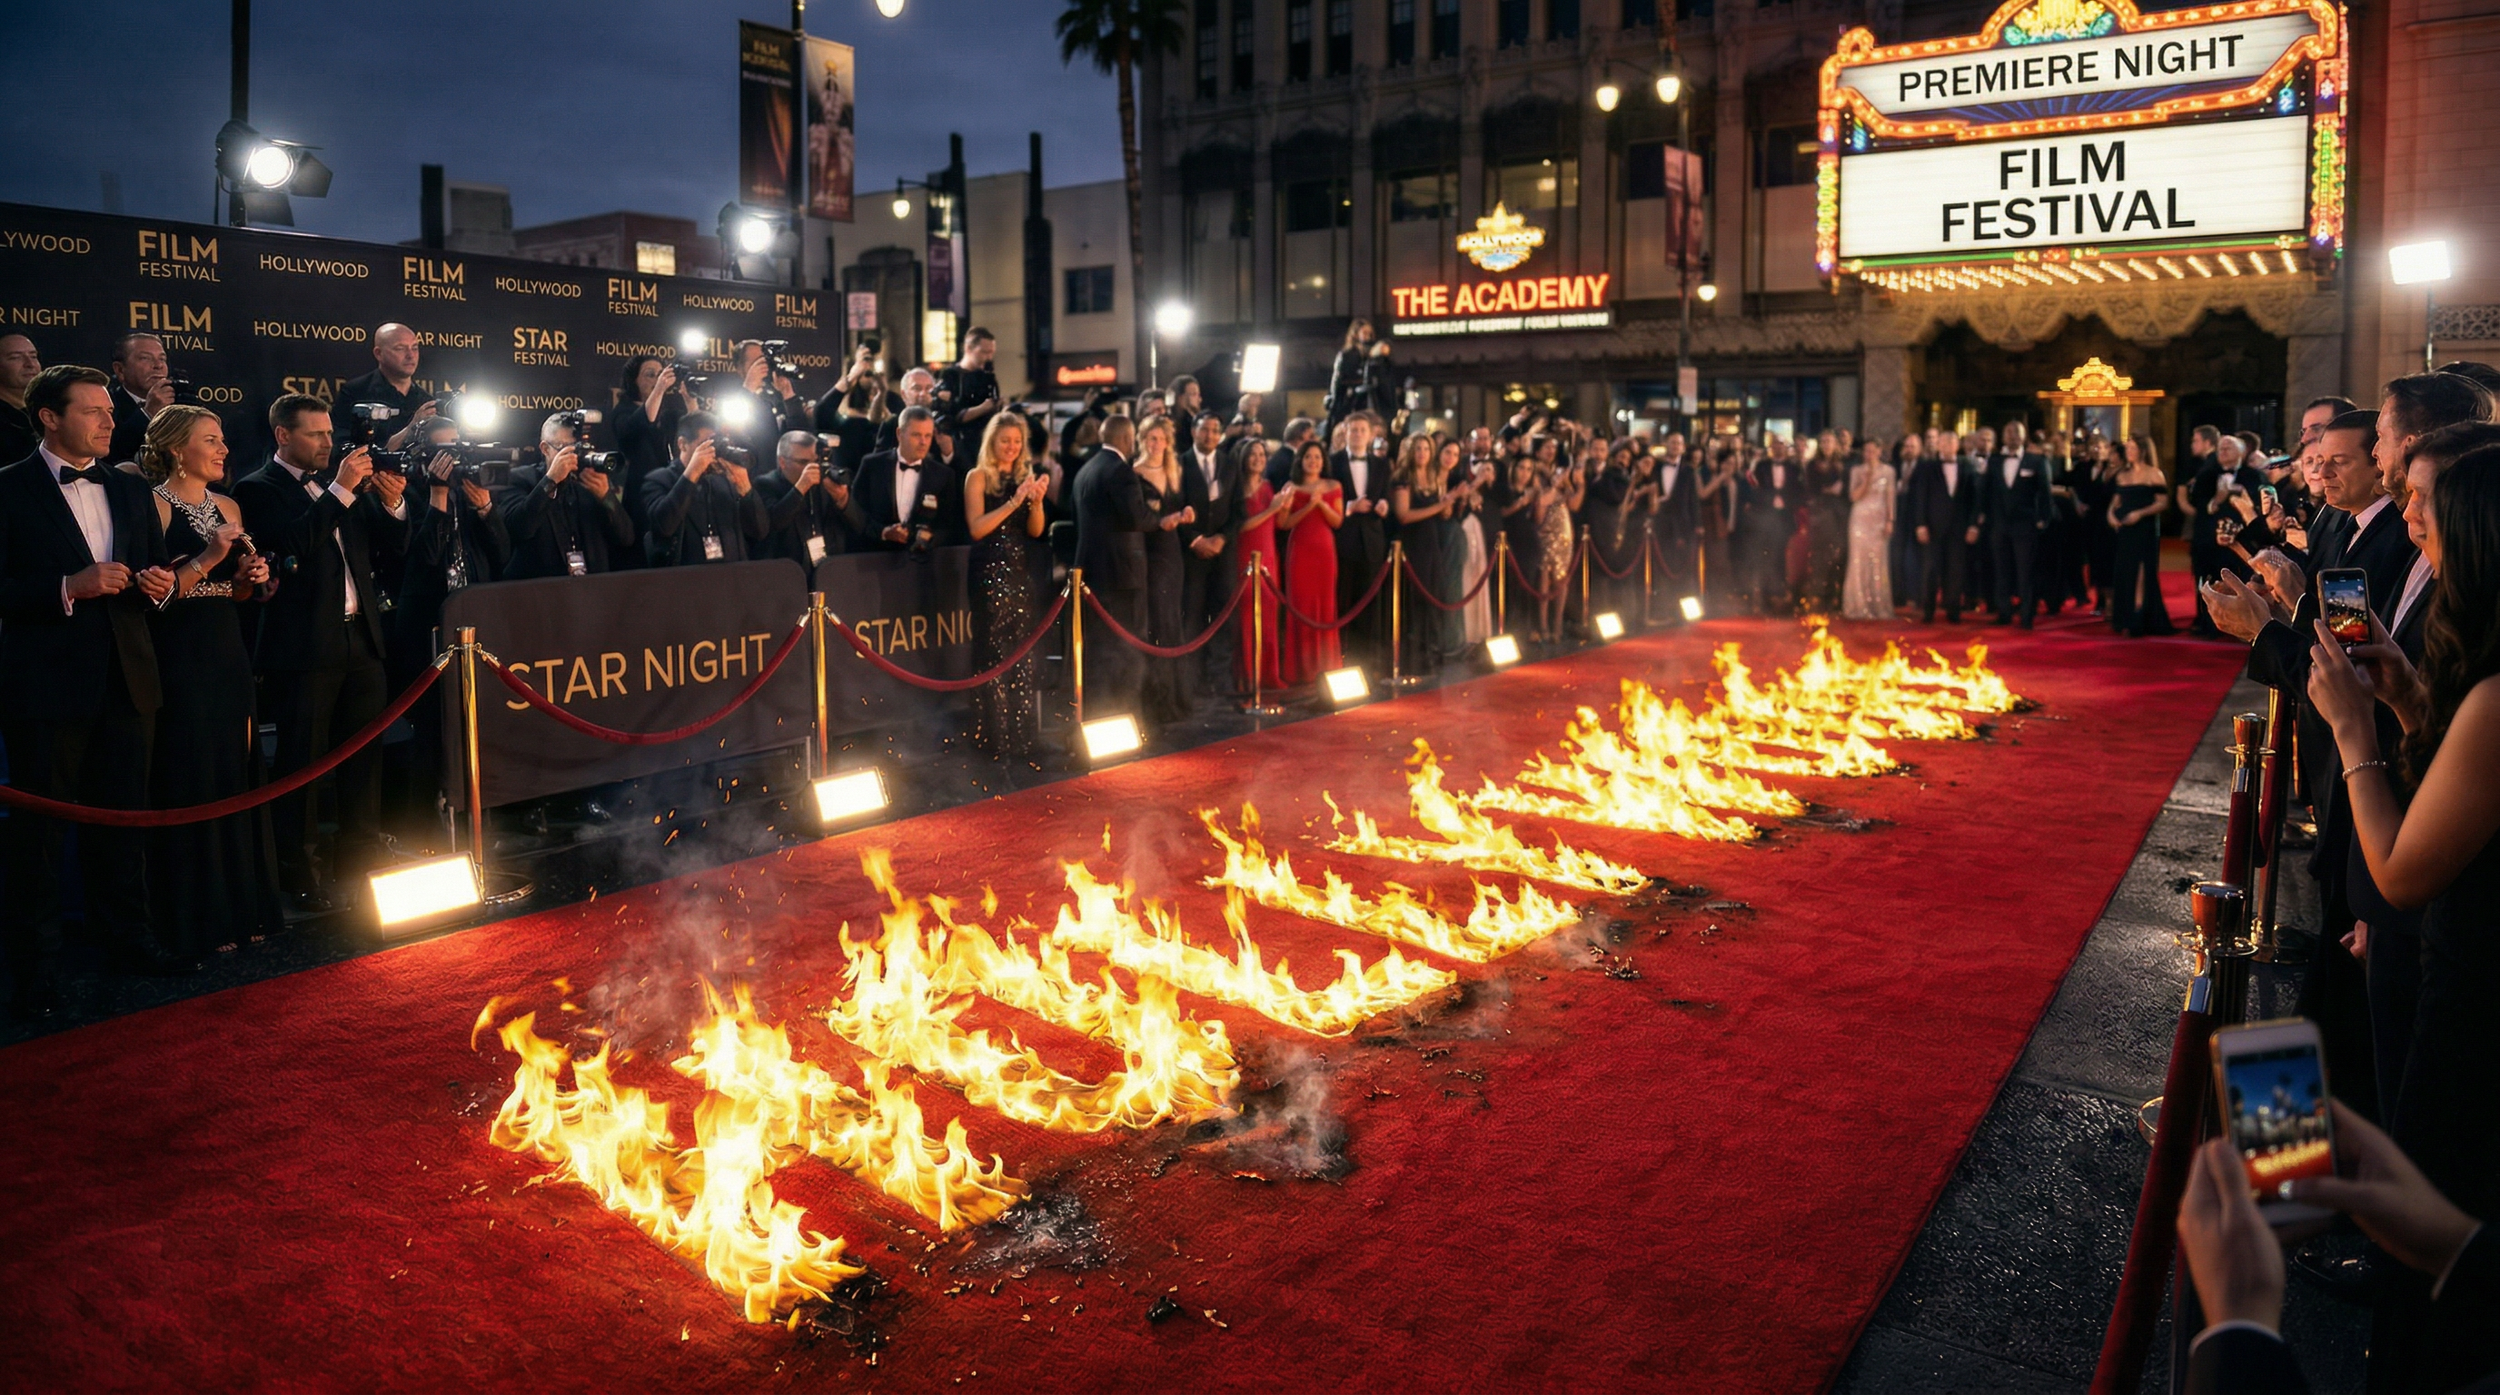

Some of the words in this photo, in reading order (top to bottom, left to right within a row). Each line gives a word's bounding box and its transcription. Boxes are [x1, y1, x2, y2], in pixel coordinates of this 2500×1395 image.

[1899, 51, 2099, 102] PREMIERE
[2115, 34, 2245, 79] NIGHT
[2000, 140, 2126, 190] FILM
[1942, 187, 2196, 242] FESTIVAL
[138, 230, 219, 264] FILM
[139, 261, 221, 283] FESTIVAL
[259, 253, 370, 279] HOLLYWOOD
[403, 256, 465, 286] FILM
[403, 283, 467, 302] FESTIVAL
[495, 275, 583, 299] HOLLYWOOD
[607, 277, 658, 302] FILM
[1391, 285, 1450, 317] THE
[1453, 272, 1610, 315] ACADEMY
[607, 300, 660, 318] FESTIVAL
[683, 294, 755, 312] HOLLYWOOD
[775, 293, 817, 317] FILM
[12, 307, 81, 327] NIGHT
[129, 301, 213, 333] FILM
[161, 334, 215, 352] TIVAL
[253, 320, 368, 344] HOLLYWOOD
[415, 332, 435, 346] AR
[438, 333, 483, 349] NIGHT
[513, 327, 568, 353] STAR
[513, 351, 571, 367] FESTIVAL
[597, 341, 677, 360] HOLLYWOOD
[696, 359, 738, 373] FESTIVA
[497, 393, 583, 411] HOLLYWOOD
[854, 615, 928, 659] STAR
[505, 652, 628, 711] STAR
[644, 632, 771, 692] NIGHT
